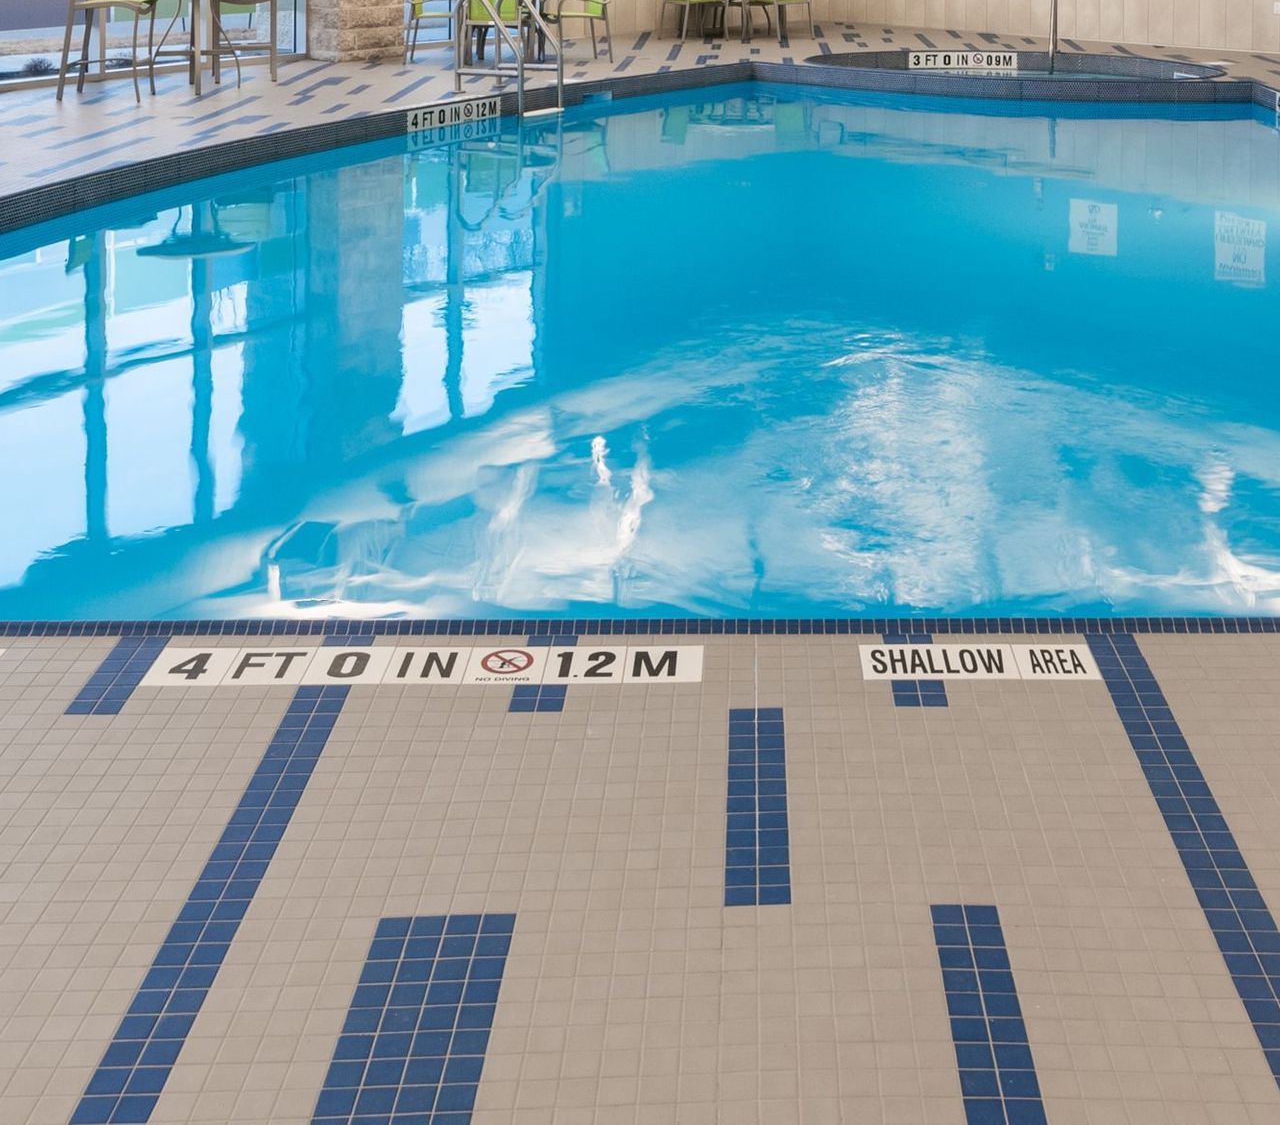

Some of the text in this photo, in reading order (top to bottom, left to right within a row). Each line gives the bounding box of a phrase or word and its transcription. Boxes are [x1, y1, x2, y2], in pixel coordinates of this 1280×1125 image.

[913, 55, 920, 66] 3
[925, 54, 938, 65] FT
[943, 55, 951, 66] 0
[956, 54, 969, 66] IN
[411, 113, 418, 129] 4
[422, 111, 434, 127] FT
[438, 109, 446, 124] 0
[450, 107, 460, 122] IN
[168, 653, 213, 680] 4
[231, 652, 308, 679] FT
[327, 652, 371, 678] 0
[396, 651, 459, 678] IN
[870, 649, 1087, 675] SHALLOW AREA
